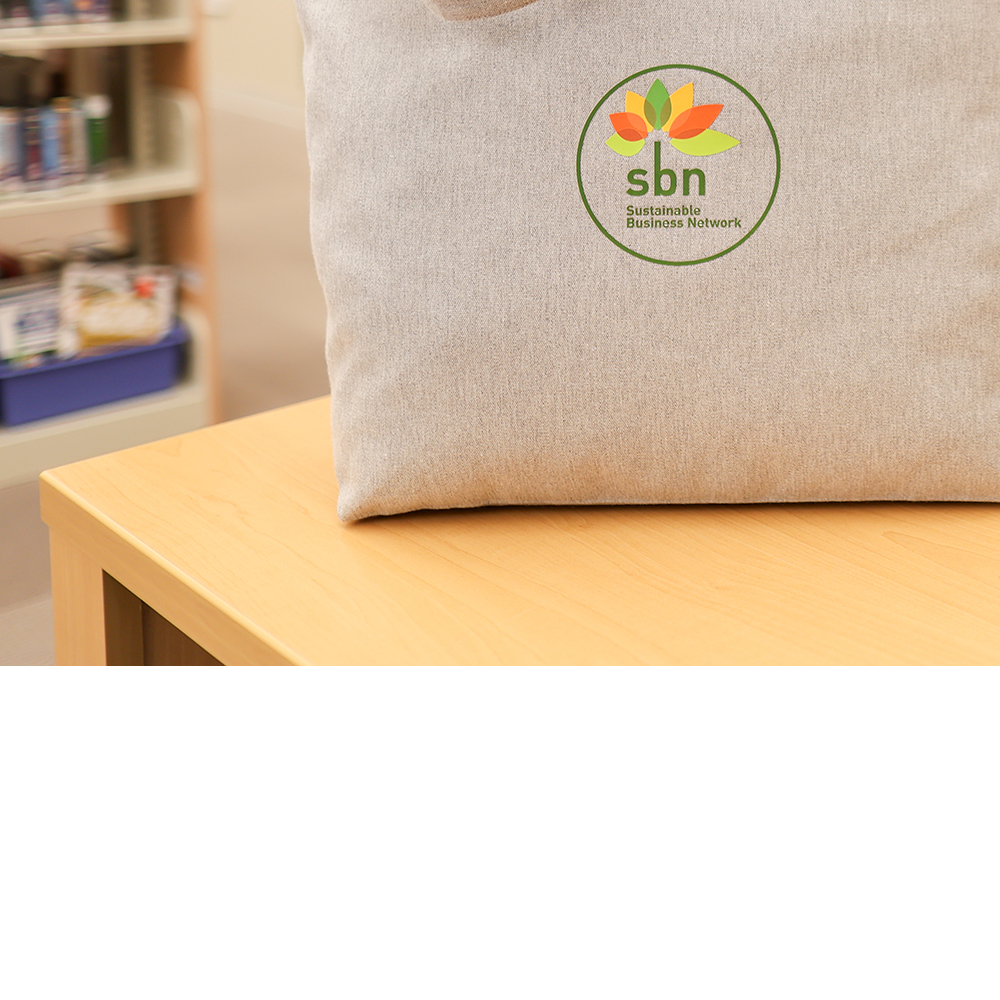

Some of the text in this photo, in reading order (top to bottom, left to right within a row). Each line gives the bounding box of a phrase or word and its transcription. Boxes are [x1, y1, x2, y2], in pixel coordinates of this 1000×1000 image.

[626, 141, 706, 197] sbn
[626, 205, 701, 216] Sustainable
[626, 217, 742, 229] Business Network
